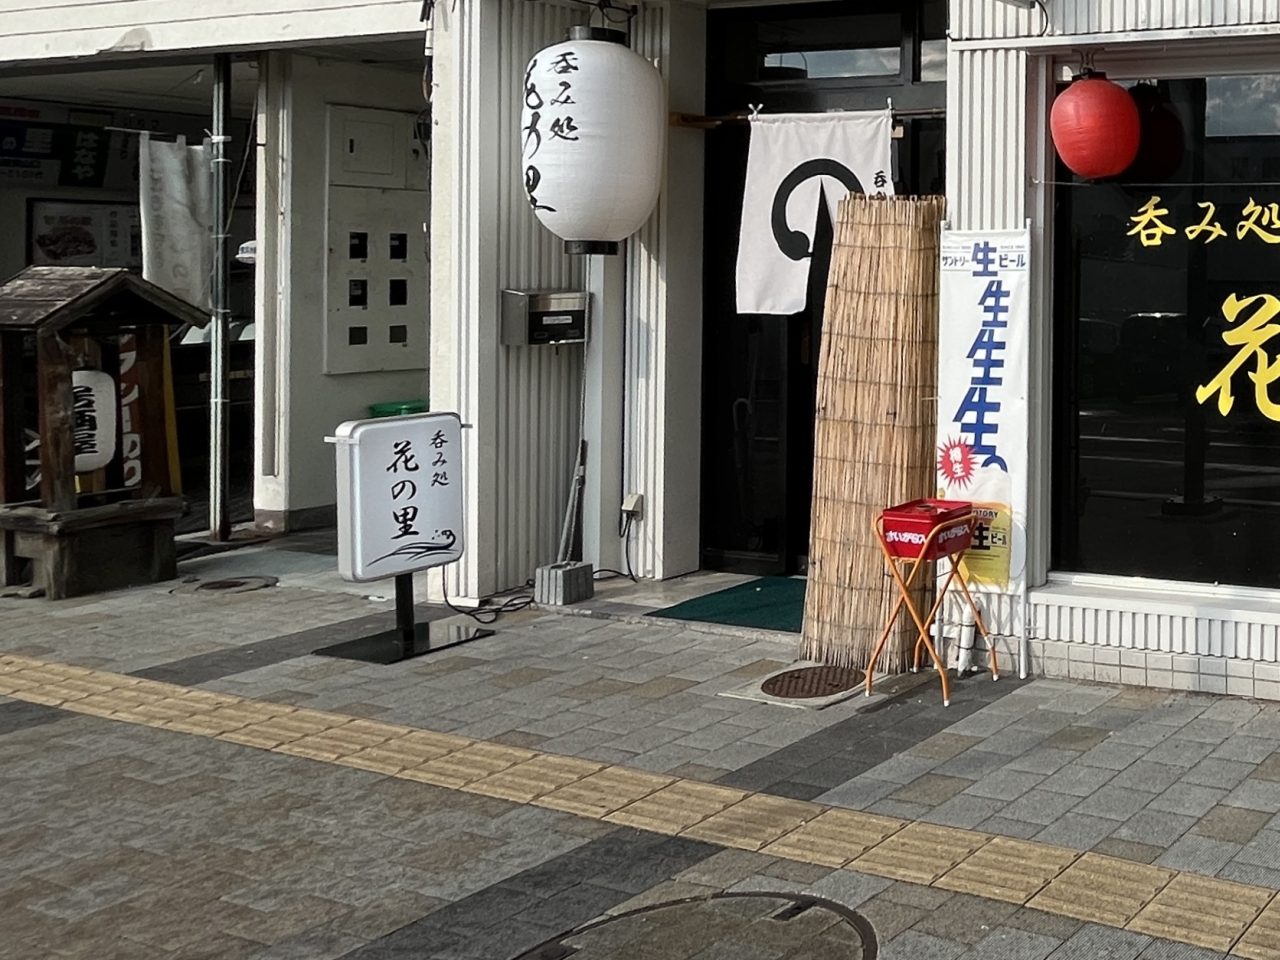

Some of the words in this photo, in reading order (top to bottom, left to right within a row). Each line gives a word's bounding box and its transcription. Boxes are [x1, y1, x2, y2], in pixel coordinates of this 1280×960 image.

[547, 51, 579, 141] 呑み処
[386, 440, 420, 540] 花の里
[429, 429, 450, 488] 呑み処
